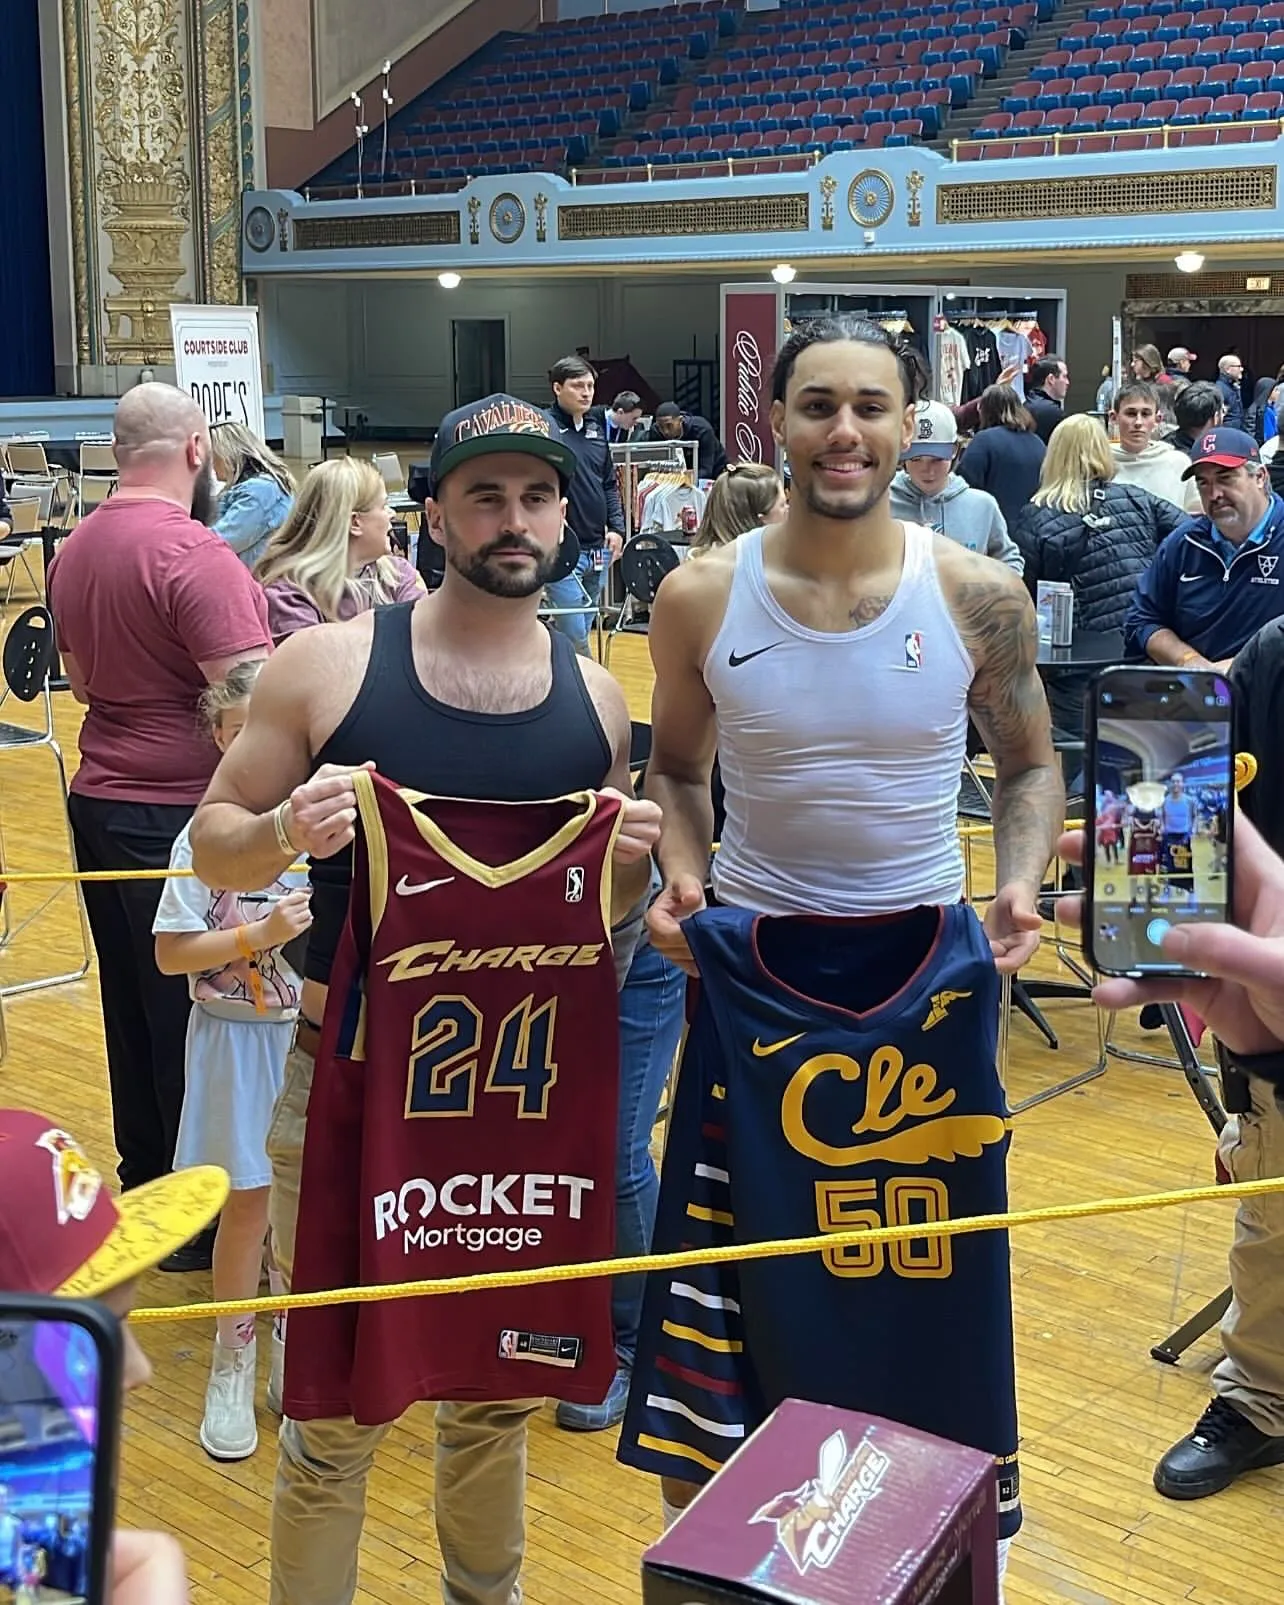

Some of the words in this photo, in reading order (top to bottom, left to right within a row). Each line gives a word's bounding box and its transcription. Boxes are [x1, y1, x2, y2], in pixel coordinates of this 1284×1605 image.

[183, 340, 228, 355] COURTSIDE
[228, 340, 249, 355] CLUB
[917, 418, 933, 439] B
[404, 993, 558, 1120] 24
[781, 1044, 1005, 1167] Cle
[373, 1173, 595, 1241] ROCKET
[403, 1223, 543, 1254] Mortgage
[814, 1176, 953, 1279] 50
